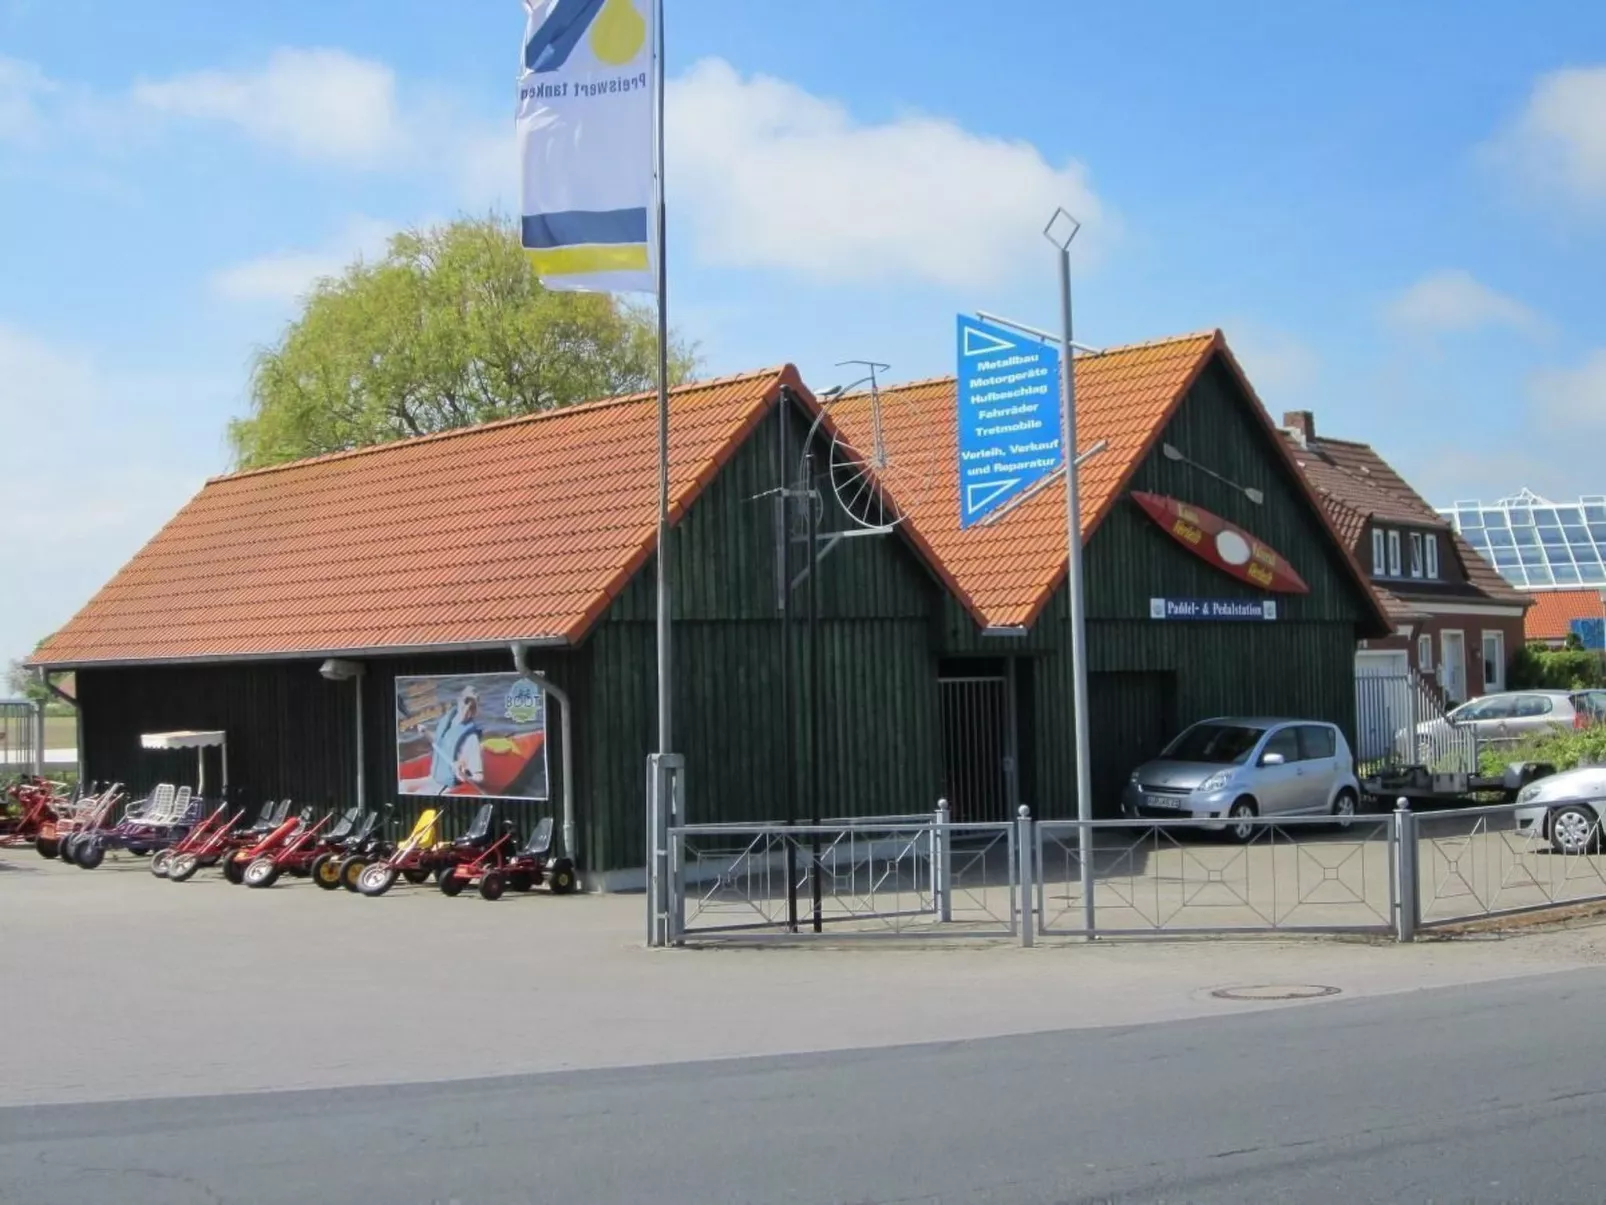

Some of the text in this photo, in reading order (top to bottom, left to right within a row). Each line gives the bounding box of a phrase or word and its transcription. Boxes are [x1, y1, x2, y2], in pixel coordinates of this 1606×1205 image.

[977, 354, 1039, 372] Metallbau
[969, 367, 1048, 389] Motorgeräte
[970, 384, 1048, 405] Hufbeschlag
[978, 403, 1039, 420] Fahrräder
[975, 419, 1043, 437] Tretmobile
[1009, 439, 1060, 454] Verkauf
[967, 457, 1056, 476] und Reparatur
[1167, 601, 1262, 616] Paddel- & Pedalstation
